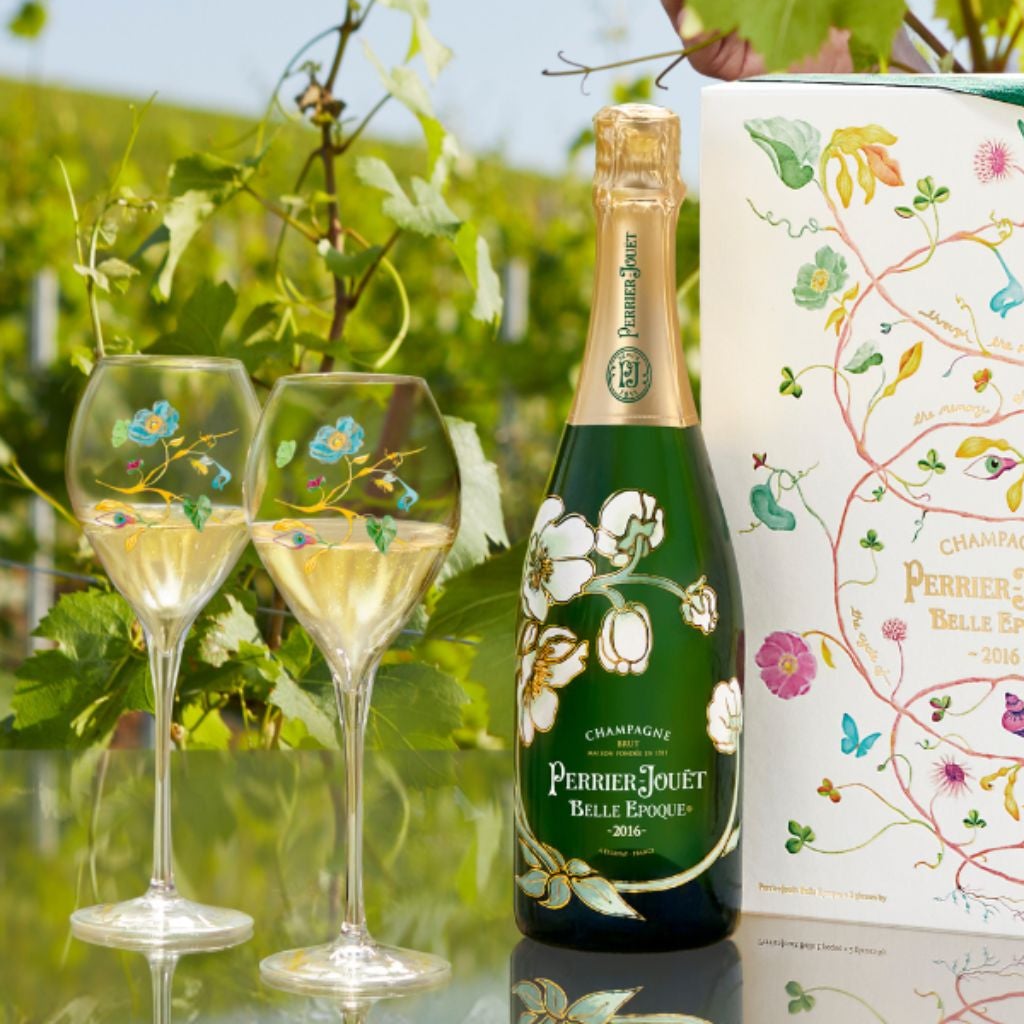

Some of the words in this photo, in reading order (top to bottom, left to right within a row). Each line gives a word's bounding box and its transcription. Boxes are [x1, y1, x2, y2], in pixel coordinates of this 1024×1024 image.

[929, 608, 992, 632] BELLE
[585, 724, 672, 742] CHAMPAGNE
[616, 740, 641, 748] BRUT
[548, 761, 707, 799] PERRIER-JOUËT
[568, 800, 620, 818] BELLE
